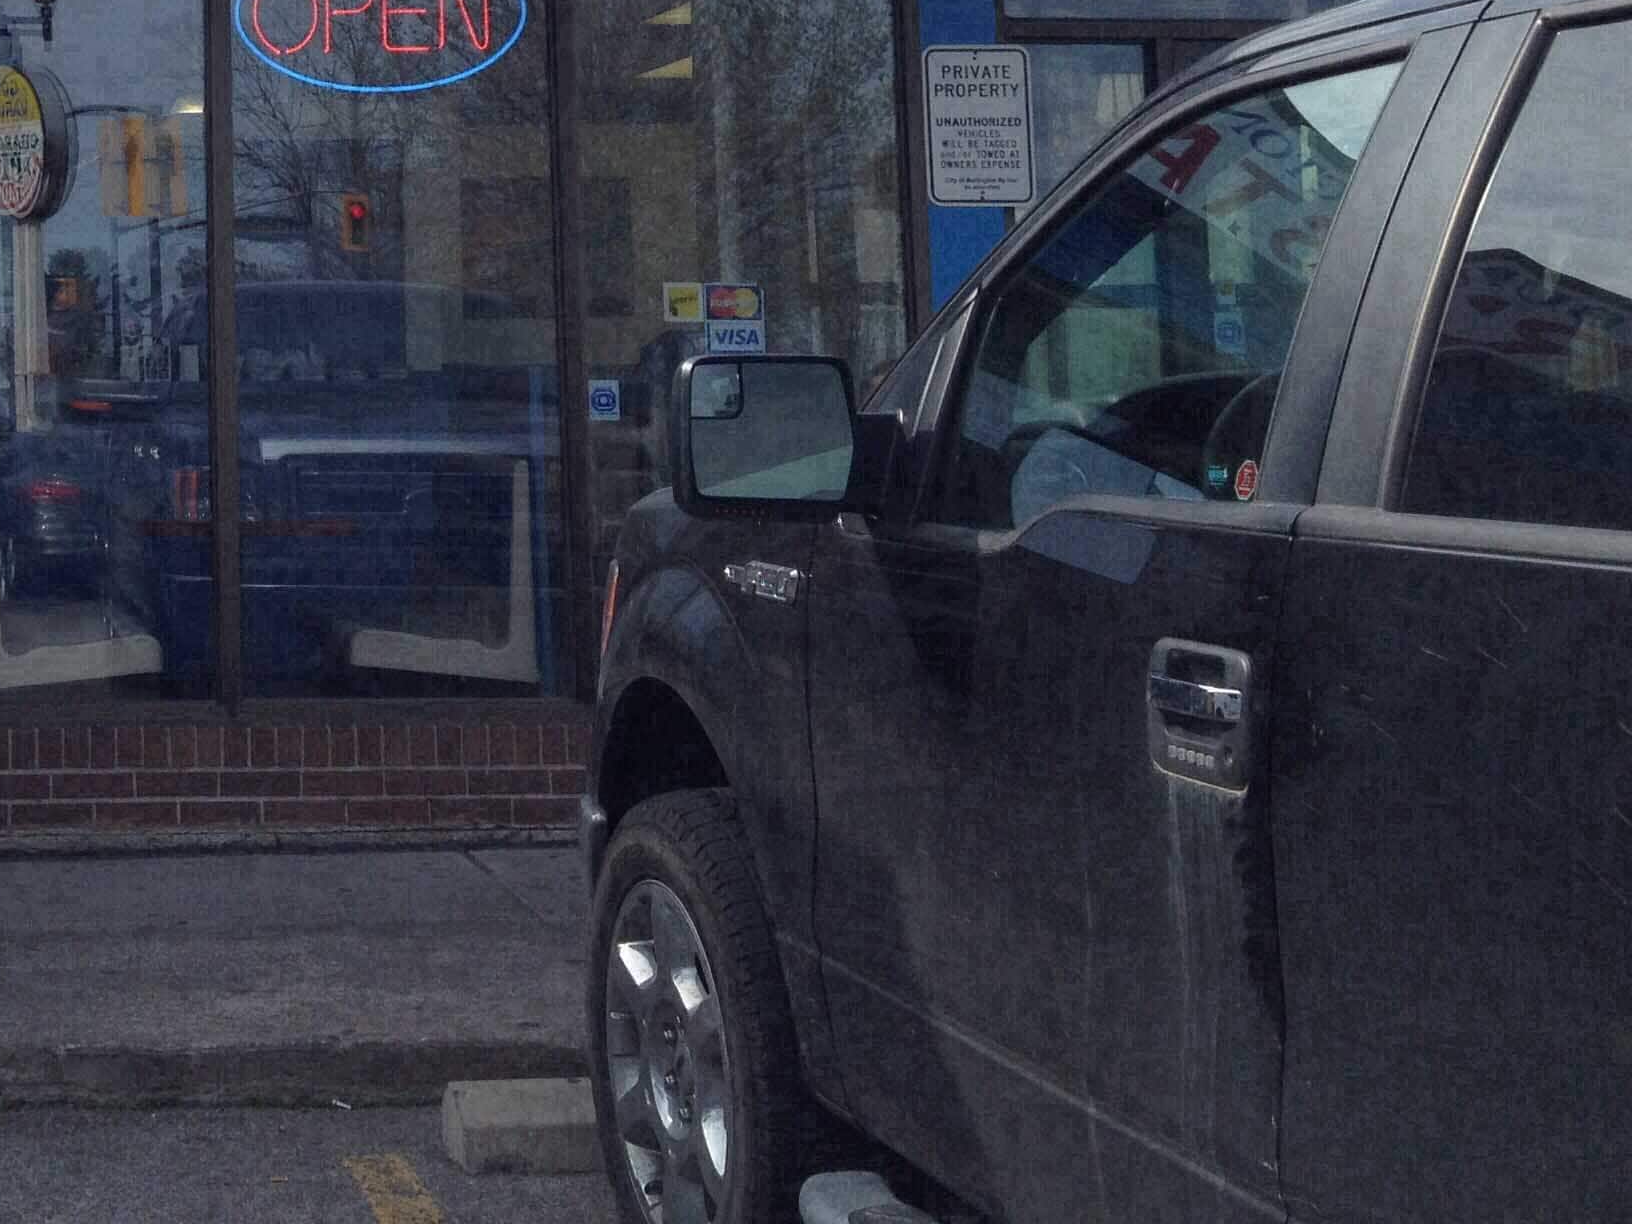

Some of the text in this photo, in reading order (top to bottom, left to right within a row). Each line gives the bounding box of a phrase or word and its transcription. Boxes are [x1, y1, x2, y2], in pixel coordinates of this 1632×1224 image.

[941, 65, 1011, 79] PRIVATE
[934, 83, 1020, 98] PROPERTY
[935, 116, 1022, 127] UNAUTHORIZED
[715, 328, 760, 345] VISA
